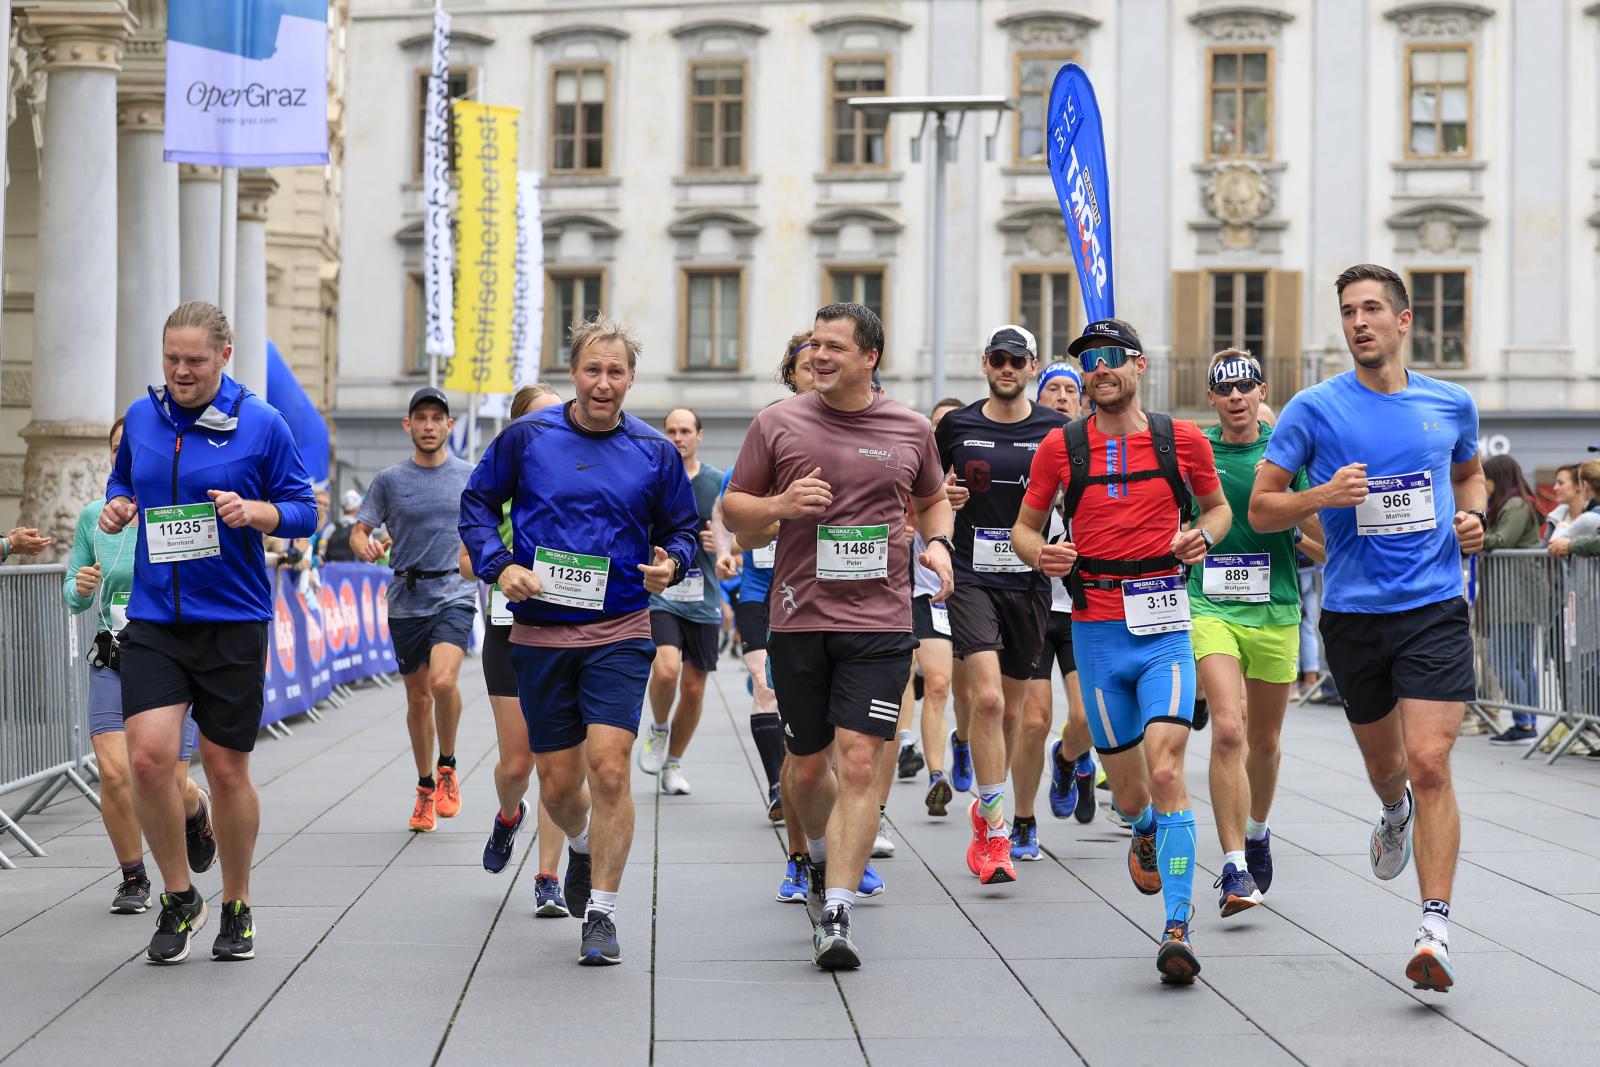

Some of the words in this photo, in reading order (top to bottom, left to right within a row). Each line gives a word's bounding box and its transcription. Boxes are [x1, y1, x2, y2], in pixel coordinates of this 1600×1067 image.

[186, 80, 307, 112] OperGraz
[216, 117, 278, 126] oper-graz.com
[470, 115, 499, 382] steirischerherbst
[1095, 323, 1109, 331] TRC
[1213, 360, 1253, 383] BUFF
[1383, 493, 1411, 508] 966
[160, 521, 201, 536] 11235
[167, 539, 195, 547] Bernhard
[834, 542, 875, 555] 11486
[549, 566, 592, 583] 11236
[1225, 569, 1249, 581] 889
[554, 584, 581, 593] Christian
[1147, 594, 1178, 609] 3:15
